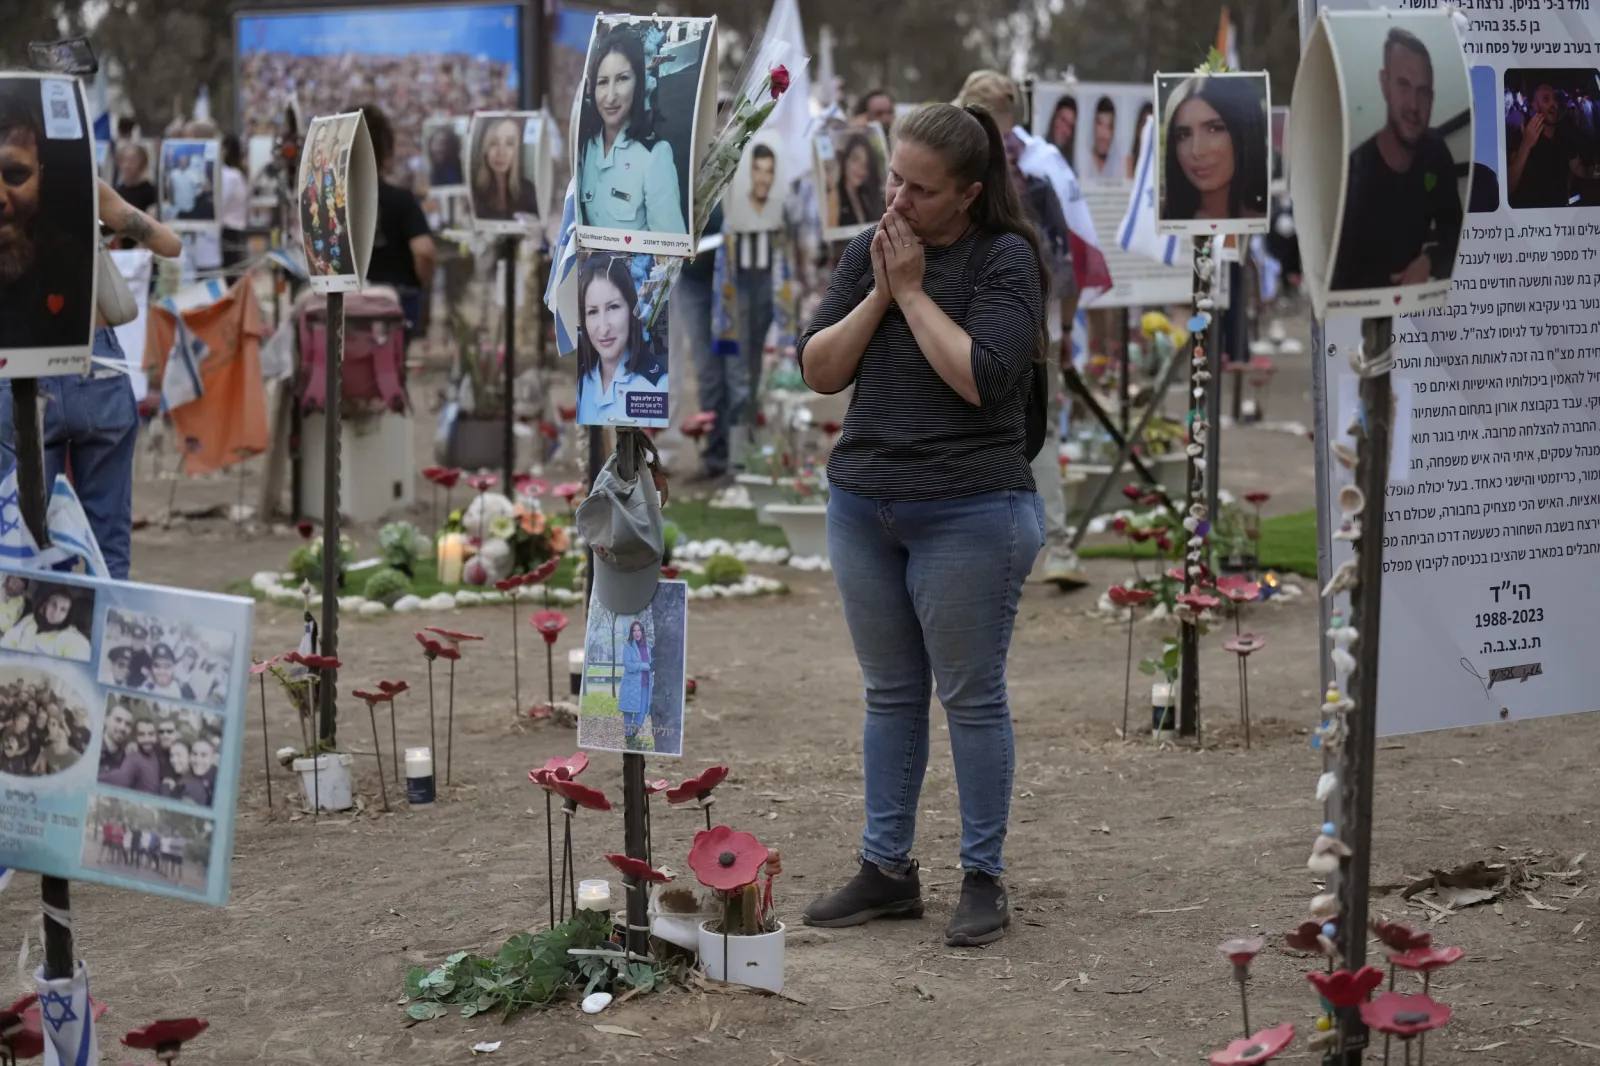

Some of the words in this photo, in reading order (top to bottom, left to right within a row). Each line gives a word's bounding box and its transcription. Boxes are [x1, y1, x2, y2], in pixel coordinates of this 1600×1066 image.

[1502, 20, 1527, 32] 35.5
[1529, 21, 1541, 35] בן
[1486, 43, 1509, 53] פסח
[1512, 40, 1528, 54] של
[1531, 43, 1561, 54] שביעי
[1564, 43, 1591, 54] בערב
[1472, 226, 1502, 239] למיכל
[1505, 226, 1515, 241] בן
[1554, 224, 1575, 236] וגדל
[1459, 251, 1490, 264] לענבל
[1493, 253, 1512, 263] נשוי
[1516, 251, 1548, 263] שתיים.
[1551, 250, 1578, 261] מספר
[1581, 248, 1597, 260] ילד
[1480, 278, 1516, 289] חודשים
[1519, 276, 1552, 287] ותשעה
[1555, 275, 1574, 286] שנה
[1577, 274, 1591, 285] בת
[1470, 302, 1494, 314] פעיל
[1497, 302, 1526, 316] ושחקן
[1529, 300, 1560, 314] עקיבא
[1563, 300, 1576, 310] בני
[1579, 299, 1600, 309] נוער
[1499, 324, 1526, 338] לגיוסו
[1529, 326, 1543, 336] עד
[1546, 323, 1588, 336] בכדורסל
[1399, 330, 1429, 343] בצבא
[1431, 330, 1457, 342] שירת
[1424, 355, 1469, 368] הצטיינות
[1472, 351, 1507, 364] לאותות
[1510, 352, 1527, 362] זכה
[1530, 351, 1544, 361] בה
[1462, 378, 1503, 390] האישיות
[1506, 374, 1549, 388] ביכולותיו
[1551, 370, 1584, 388] להאמין
[1430, 380, 1459, 392] ואיתם
[1521, 399, 1560, 413] בקבוצת
[1562, 397, 1582, 408] עבד
[1459, 404, 1493, 416] בתחום
[1495, 402, 1518, 416] אורון
[1482, 427, 1516, 439] מרובה.
[1519, 421, 1560, 436] להצלחה
[1563, 421, 1596, 433] החברה
[1432, 431, 1455, 442] בוגר
[1457, 429, 1479, 440] איתי
[1471, 453, 1490, 465] איש
[1493, 452, 1511, 463] היה
[1513, 450, 1534, 461] איתי
[1537, 448, 1572, 463] עסקים,
[1426, 455, 1469, 471] משפחה,
[1471, 478, 1502, 490] כאחד.
[1505, 475, 1535, 487] והישגי
[1538, 472, 1576, 484] כריזמטי
[1417, 481, 1444, 494] יכולת
[1447, 479, 1468, 492] בעל
[1483, 501, 1517, 517] מצחיק
[1519, 500, 1535, 511] הכי
[1538, 497, 1564, 509] האיש
[1404, 507, 1436, 520] שכולם
[1439, 504, 1480, 520] בחבורה,
[1503, 524, 1542, 536] השחורה
[1545, 521, 1574, 533] בשבת
[1401, 533, 1434, 546] הביתה
[1437, 531, 1460, 543] דרכו
[1462, 528, 1500, 540] כשעשה
[1491, 550, 1526, 563] שהציבו
[1529, 546, 1564, 559] במארב
[1415, 555, 1450, 573] לקיבוץ
[1452, 554, 1488, 566] בכניסה
[1475, 607, 1544, 628] 1988-2023
